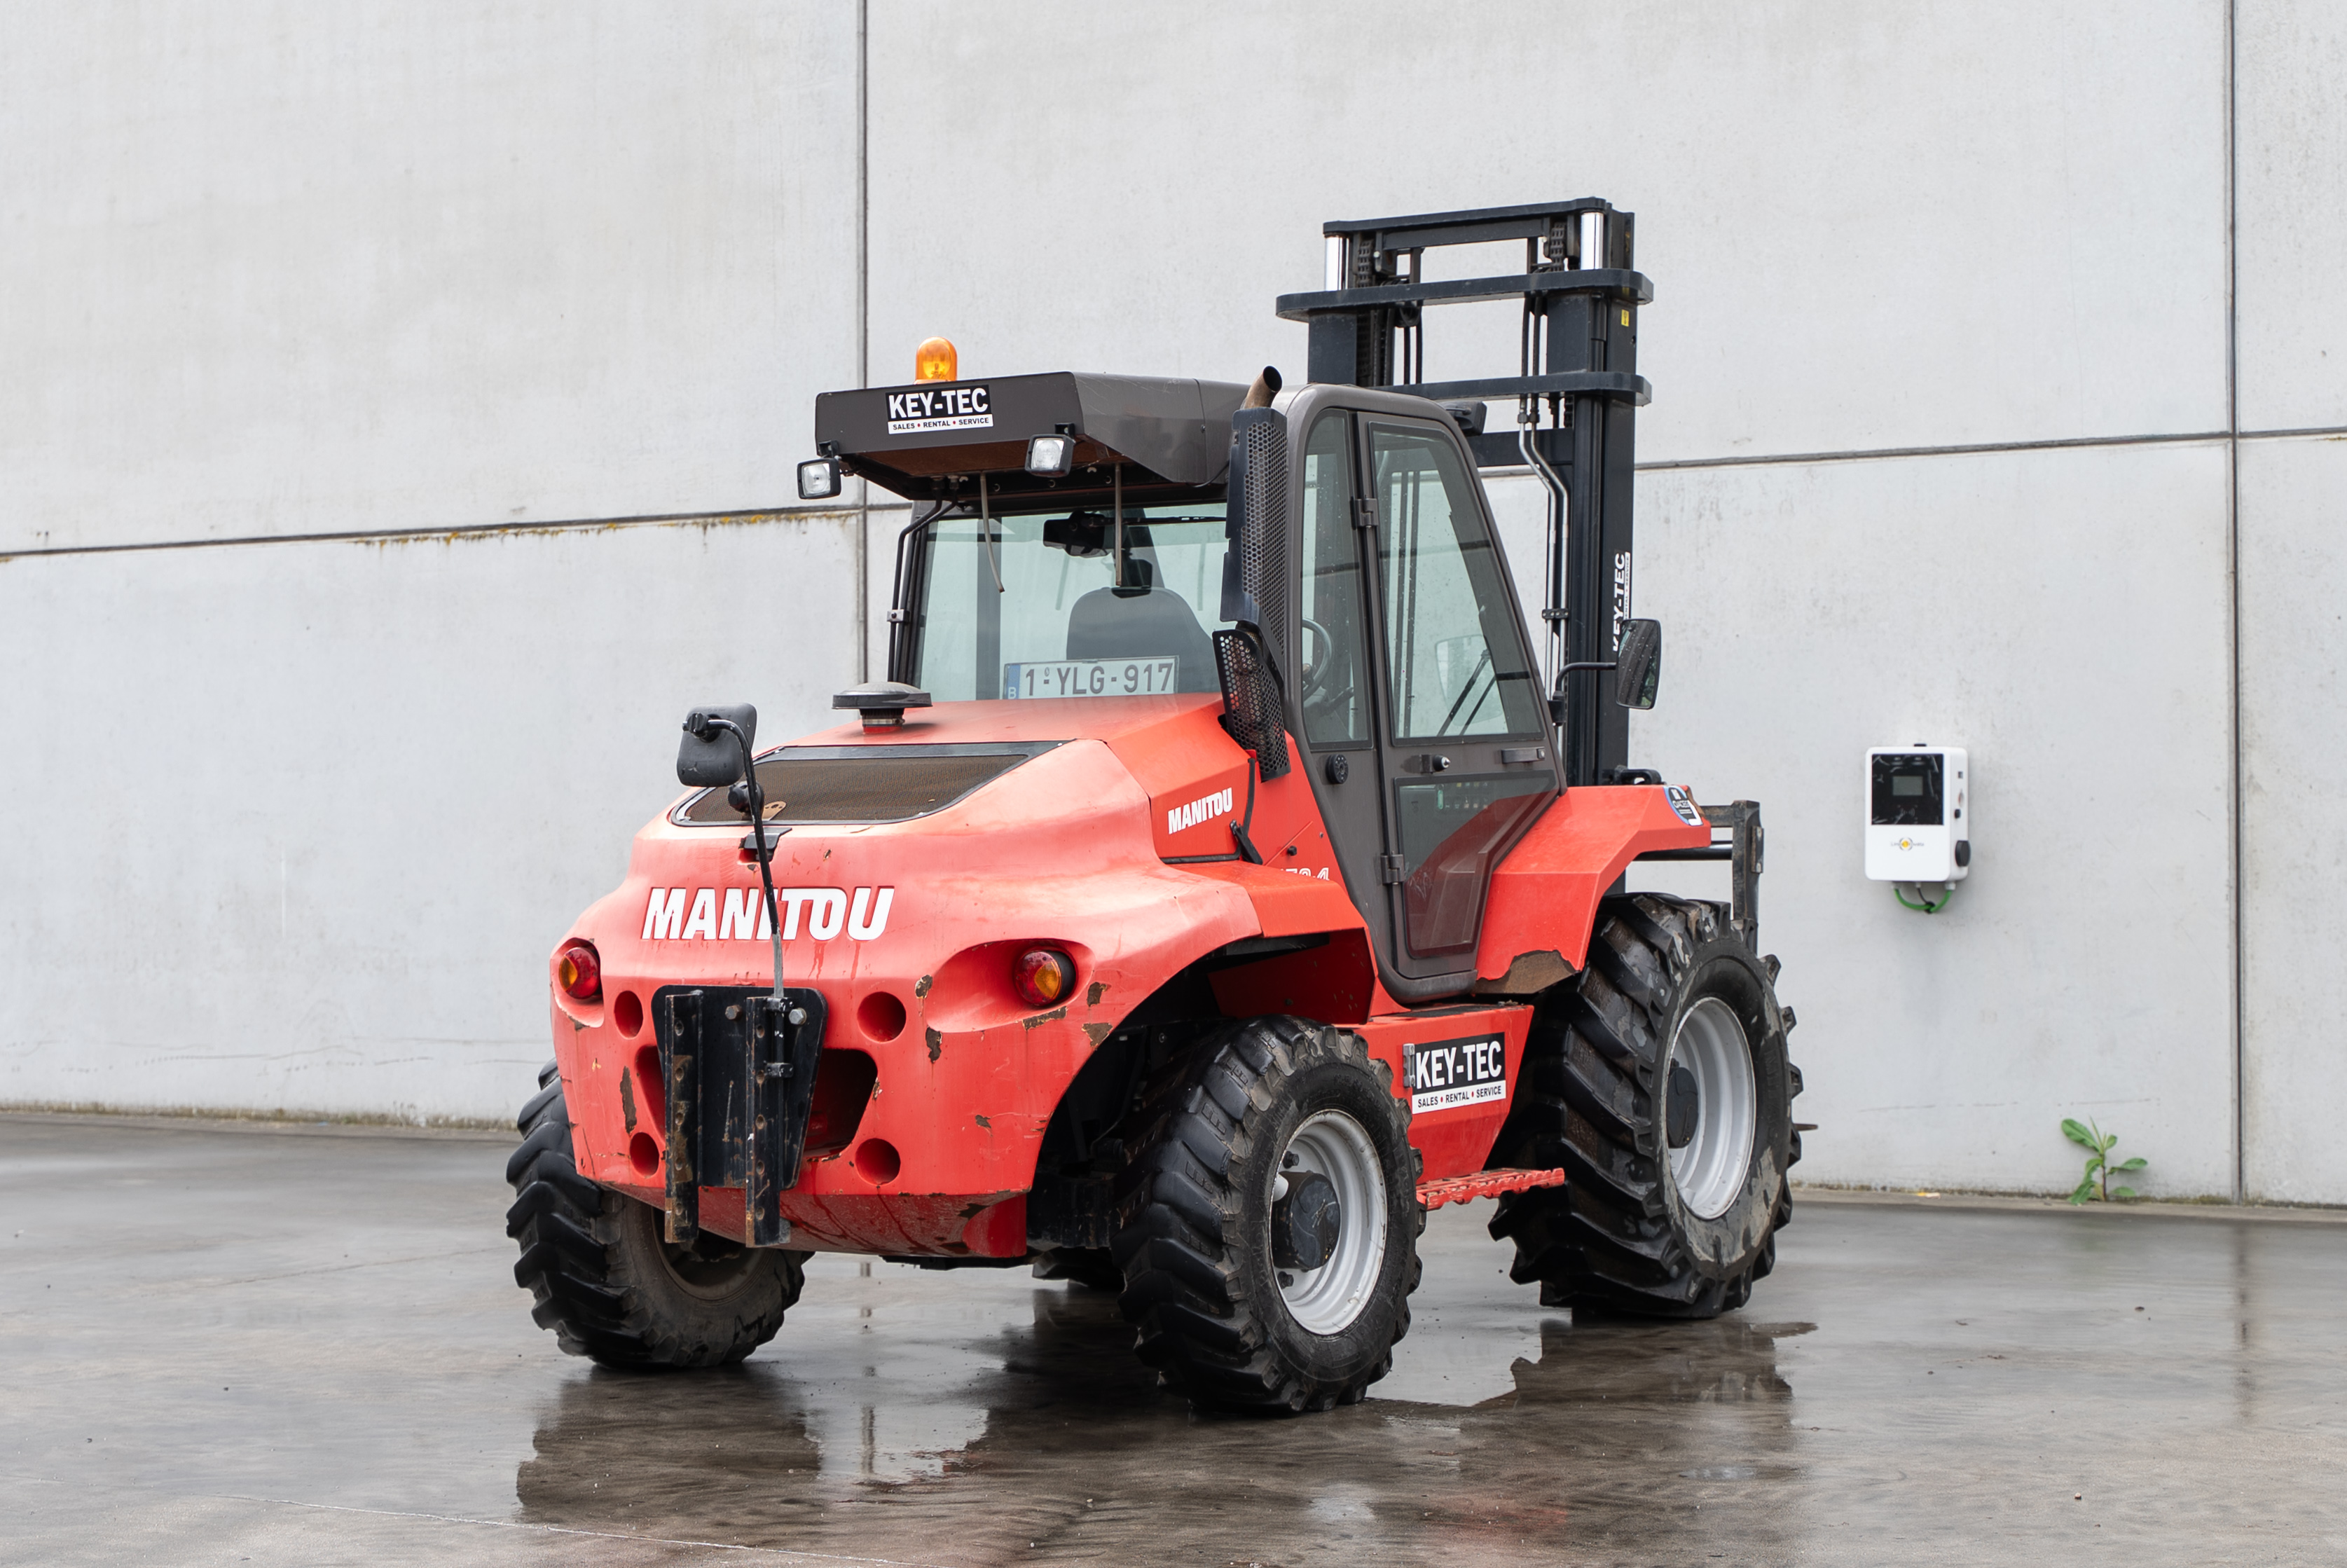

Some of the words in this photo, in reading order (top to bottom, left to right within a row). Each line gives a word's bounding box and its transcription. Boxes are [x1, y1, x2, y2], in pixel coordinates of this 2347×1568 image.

[888, 387, 988, 419] KEY-TEC
[958, 417, 989, 425] SERVICE
[1168, 787, 1232, 834] MANITOU
[641, 887, 895, 941] MANITOU
[1416, 1040, 1502, 1089] KEY-TEC
[1418, 1096, 1438, 1108] SALES
[1445, 1092, 1469, 1103] RENTAL
[1476, 1085, 1501, 1098] SERVICE
